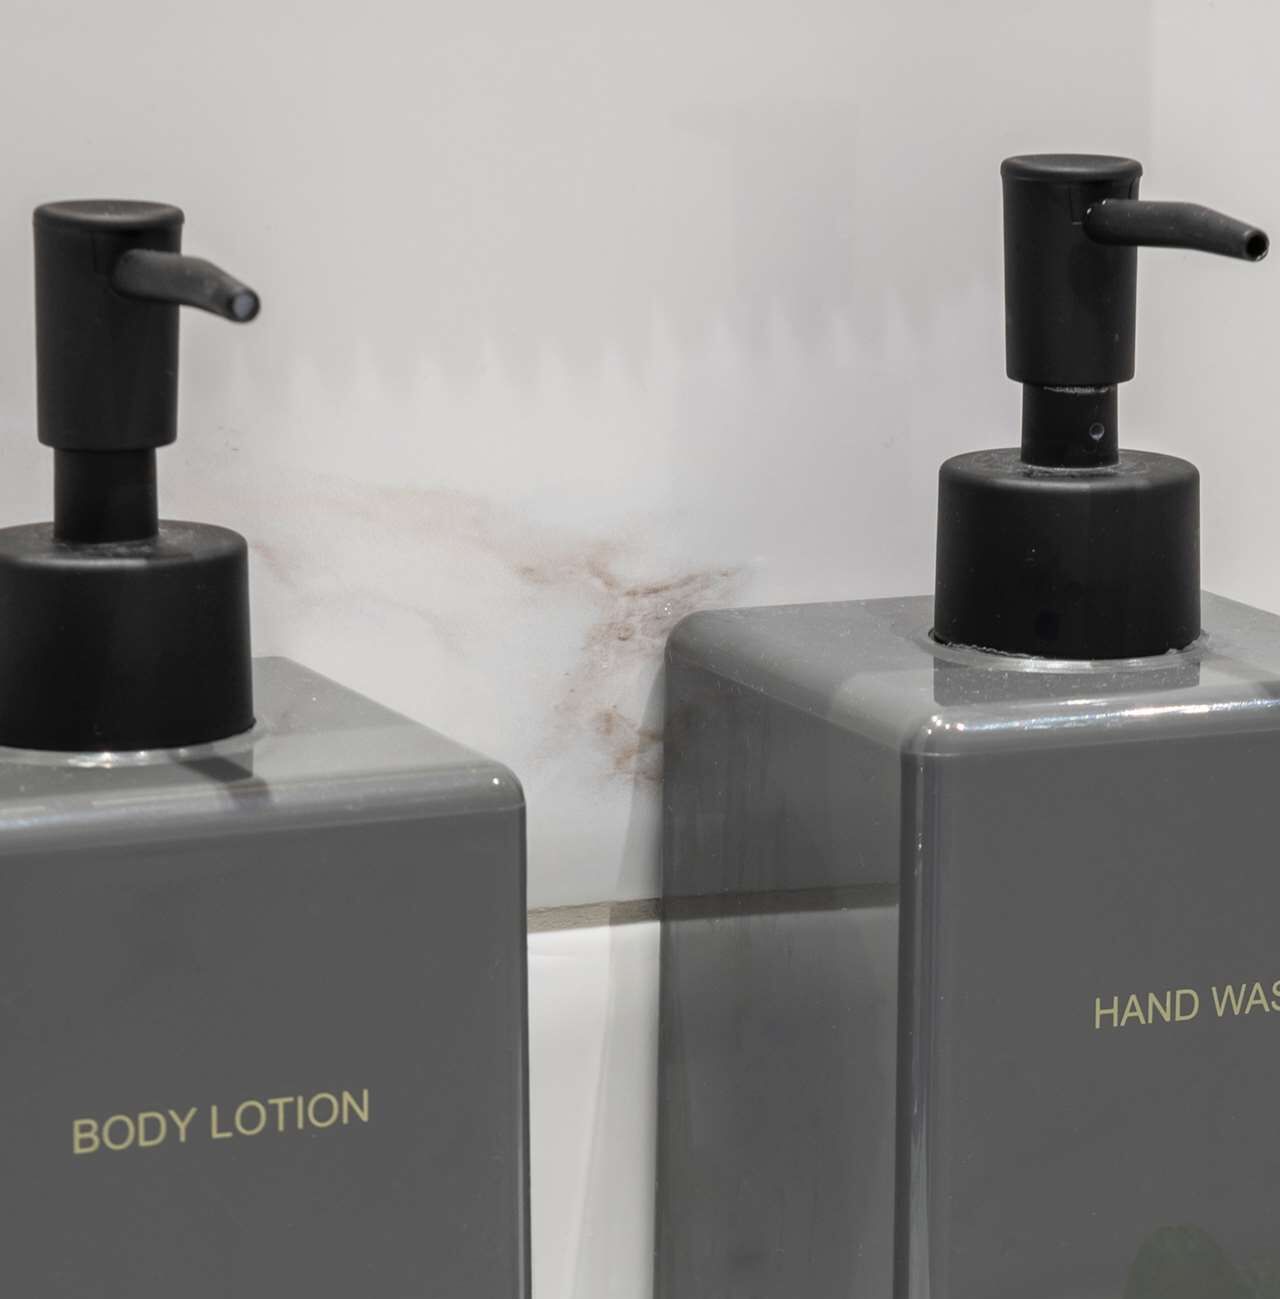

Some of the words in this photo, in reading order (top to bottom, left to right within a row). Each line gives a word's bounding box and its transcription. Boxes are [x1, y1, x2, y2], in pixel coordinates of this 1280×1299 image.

[1094, 988, 1200, 1029] HAND
[72, 1106, 198, 1155] BODY
[210, 1088, 369, 1140] LOTION
